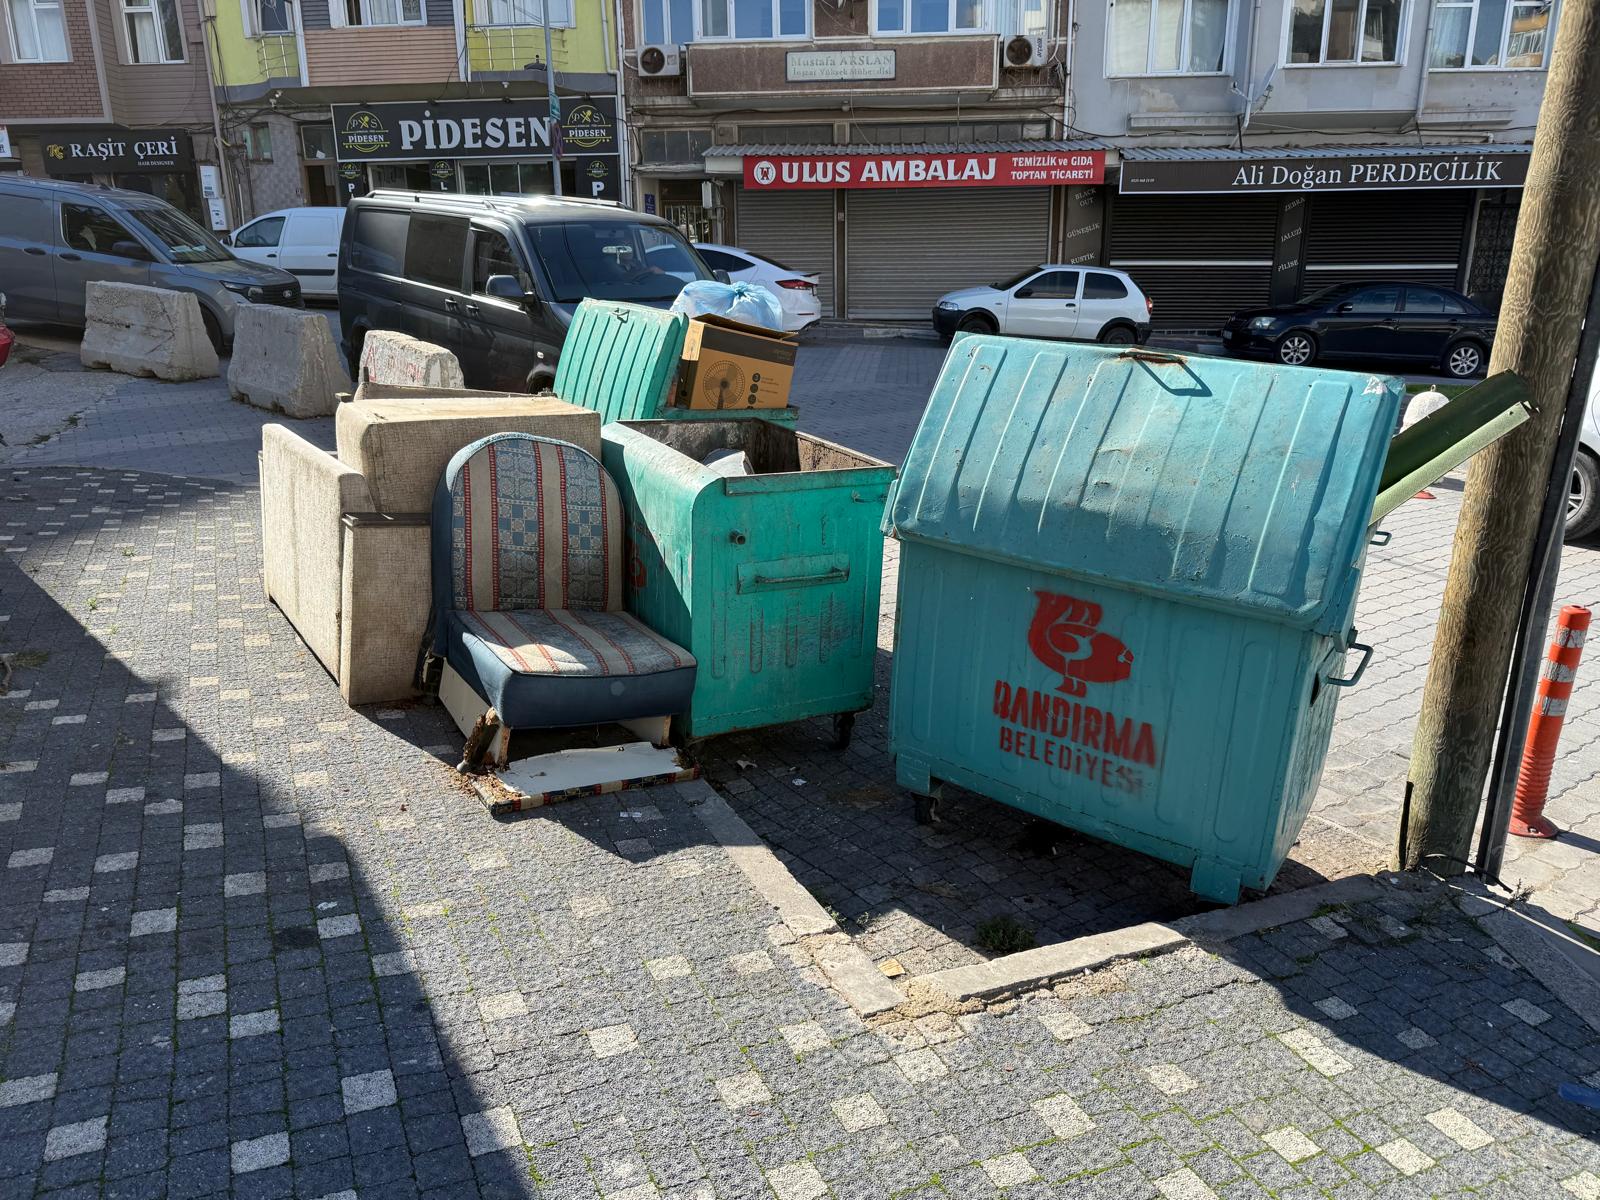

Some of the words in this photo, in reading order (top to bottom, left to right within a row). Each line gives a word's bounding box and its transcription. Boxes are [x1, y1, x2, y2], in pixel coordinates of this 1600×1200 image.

[840, 55, 892, 66] ARSLAN
[398, 110, 550, 150] PİDESEN
[568, 127, 606, 137] PİDESEN
[348, 133, 384, 143] PİDESEN
[69, 137, 126, 161] RAŞİT
[134, 135, 178, 160] ÇERİ
[1011, 154, 1057, 167] TEMİZLİK
[1058, 158, 1068, 166] ve
[1071, 156, 1093, 166] GIDA
[781, 161, 851, 183] ULUS
[860, 158, 997, 182] AMBALAJ
[1010, 170, 1047, 180] TOPTAN
[1050, 167, 1094, 179] TİCARETİ
[1231, 165, 1264, 186] Ali
[1270, 164, 1342, 189] Doğan
[1348, 156, 1503, 183] PERDECİLİK
[1074, 187, 1097, 200] BLACK
[1079, 197, 1094, 208] OUT
[1284, 196, 1306, 212] ZEBRA
[992, 679, 1157, 769] BANDIRMA
